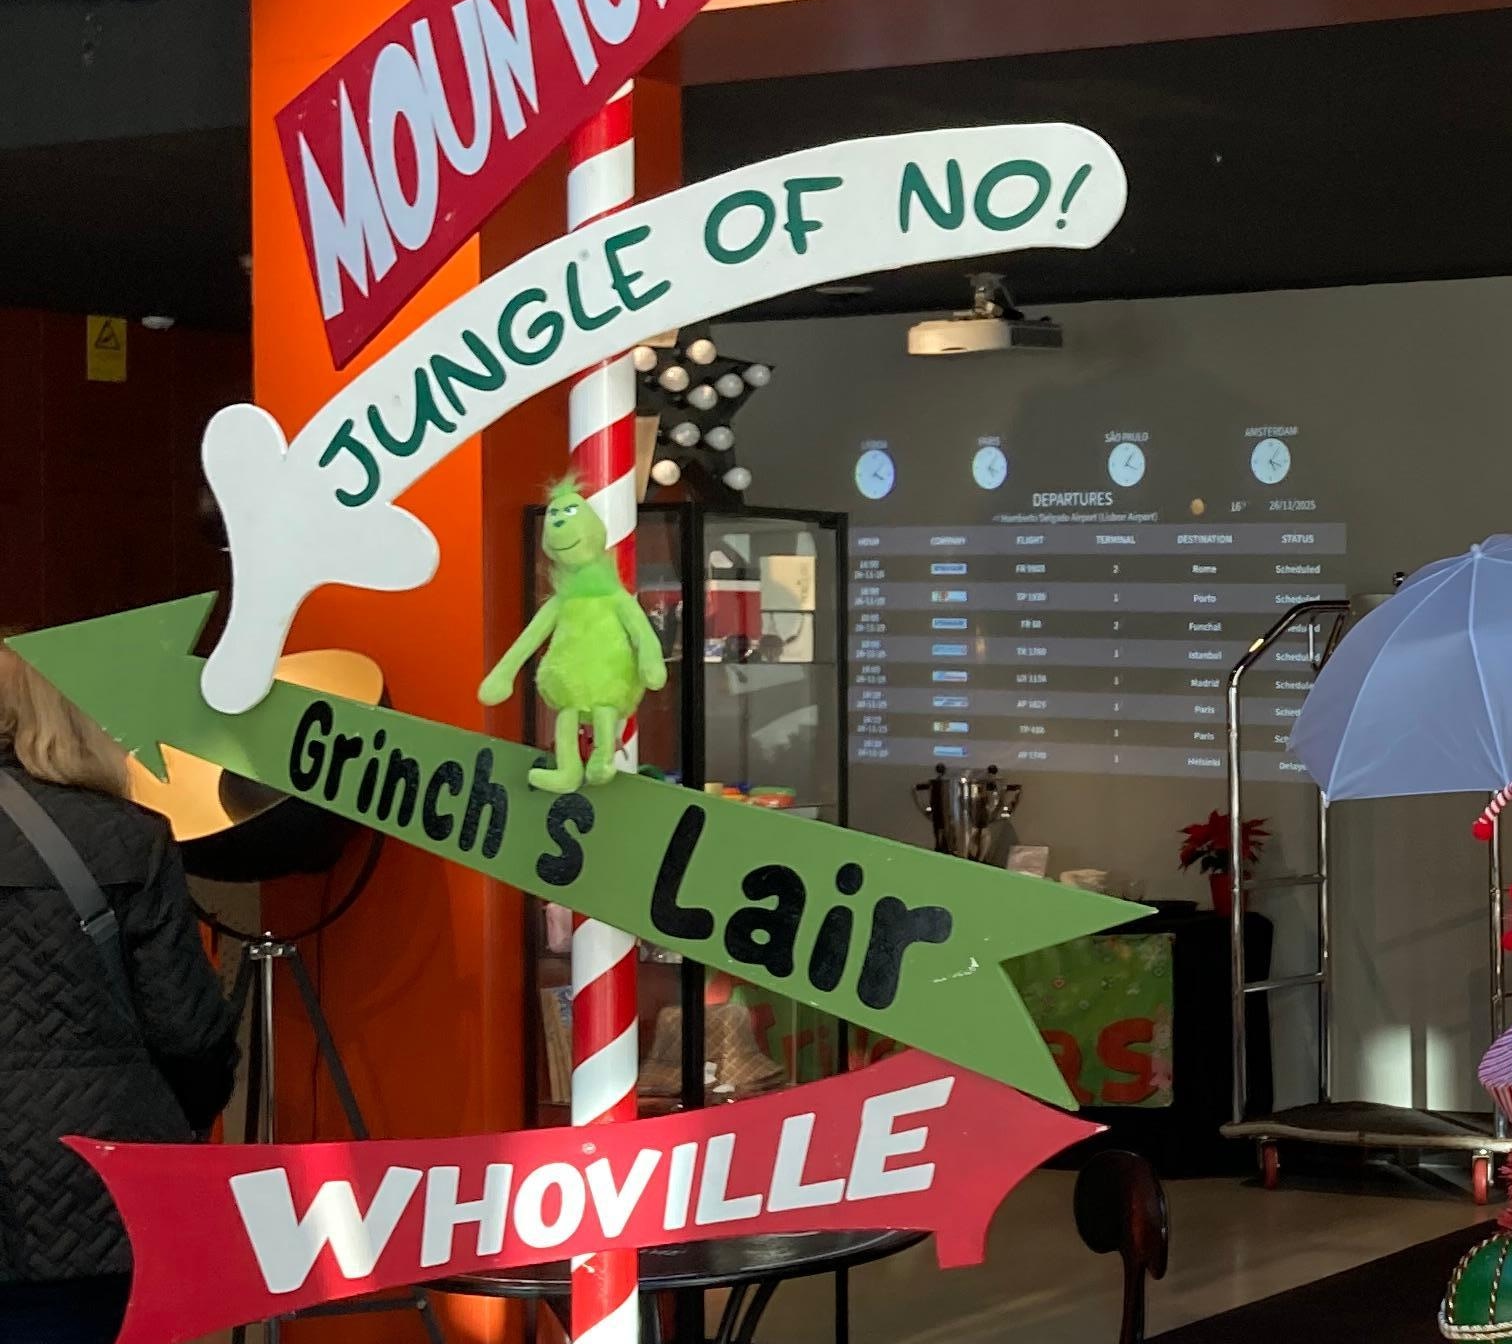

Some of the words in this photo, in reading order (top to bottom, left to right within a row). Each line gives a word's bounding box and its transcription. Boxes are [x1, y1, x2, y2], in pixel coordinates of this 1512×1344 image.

[318, 225, 671, 508] JUNGLE
[704, 176, 843, 265] OF
[899, 158, 1092, 233] NO!
[1244, 426, 1299, 437] AMSTERDAM
[1032, 492, 1114, 507] DEPARTURES
[1016, 535, 1045, 545] FLIGHT
[1095, 535, 1136, 545] TERMINAL
[1177, 534, 1233, 544] DESTINATION
[1281, 533, 1315, 544] STATUS
[1275, 564, 1321, 574] Scheduled
[1193, 594, 1217, 603] Porto
[1188, 622, 1222, 632] Funchal
[1188, 651, 1223, 660] Istanbul
[1275, 652, 1321, 662] Scheduld
[1190, 679, 1220, 688] Madrid
[1275, 681, 1314, 690] Schedule
[1194, 706, 1216, 714] Paris
[1275, 708, 1303, 717] Sched
[1193, 732, 1215, 741] Paris
[1188, 758, 1221, 767] Helsinki
[1279, 762, 1306, 772] Delay
[649, 804, 952, 1011] Lair
[229, 1076, 955, 1294] WHOVILLE
